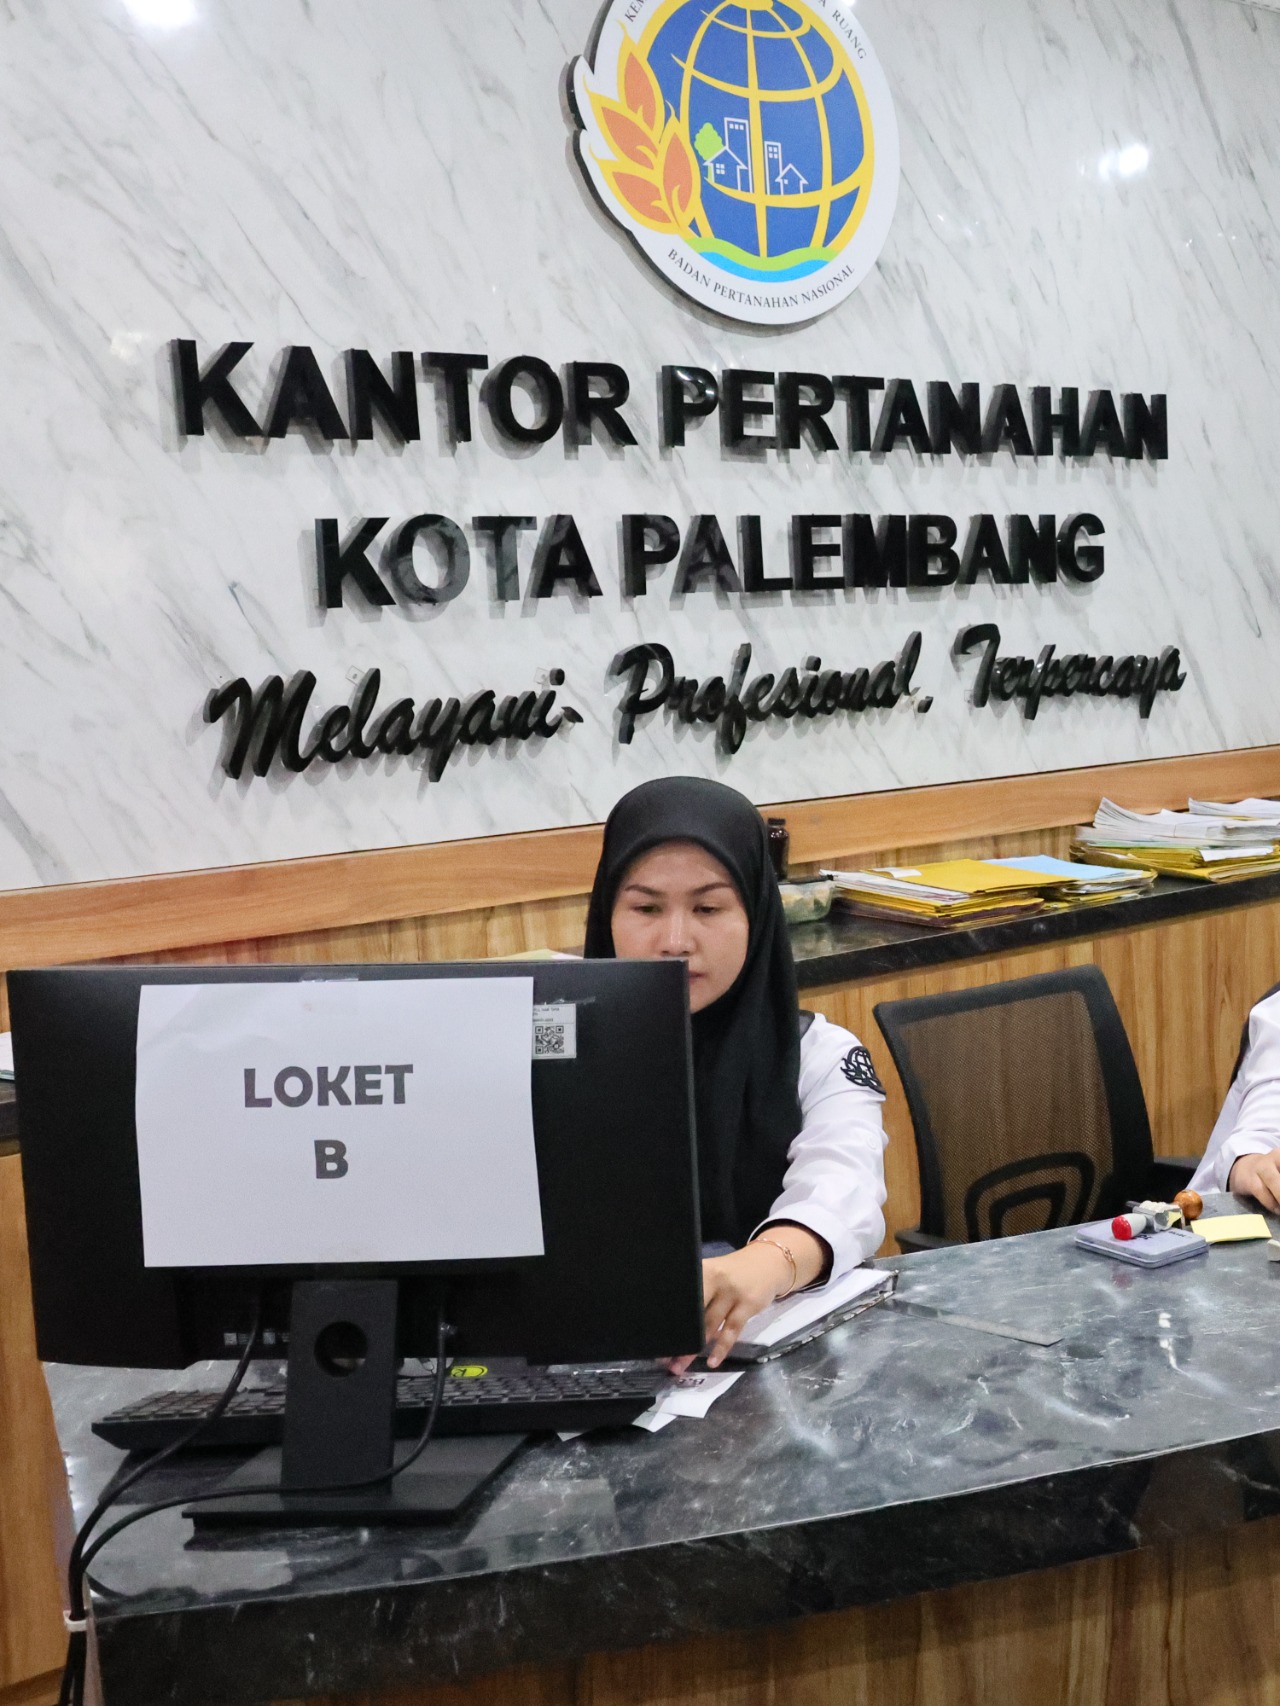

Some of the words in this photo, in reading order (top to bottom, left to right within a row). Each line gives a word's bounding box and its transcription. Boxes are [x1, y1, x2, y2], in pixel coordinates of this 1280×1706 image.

[831, 9, 868, 60] RUANG
[667, 248, 711, 287] BADAN
[713, 283, 799, 308] PERTANAHAN
[801, 264, 856, 301] NASIONAL
[170, 338, 638, 448] KANTOR
[661, 365, 1168, 460] PERTANAHAN
[315, 512, 603, 609] KOTA
[621, 512, 1106, 597] PALEMBANG
[950, 623, 1188, 721] Terpercaya
[243, 1063, 414, 1109] LOKET
[313, 1139, 349, 1180] B
